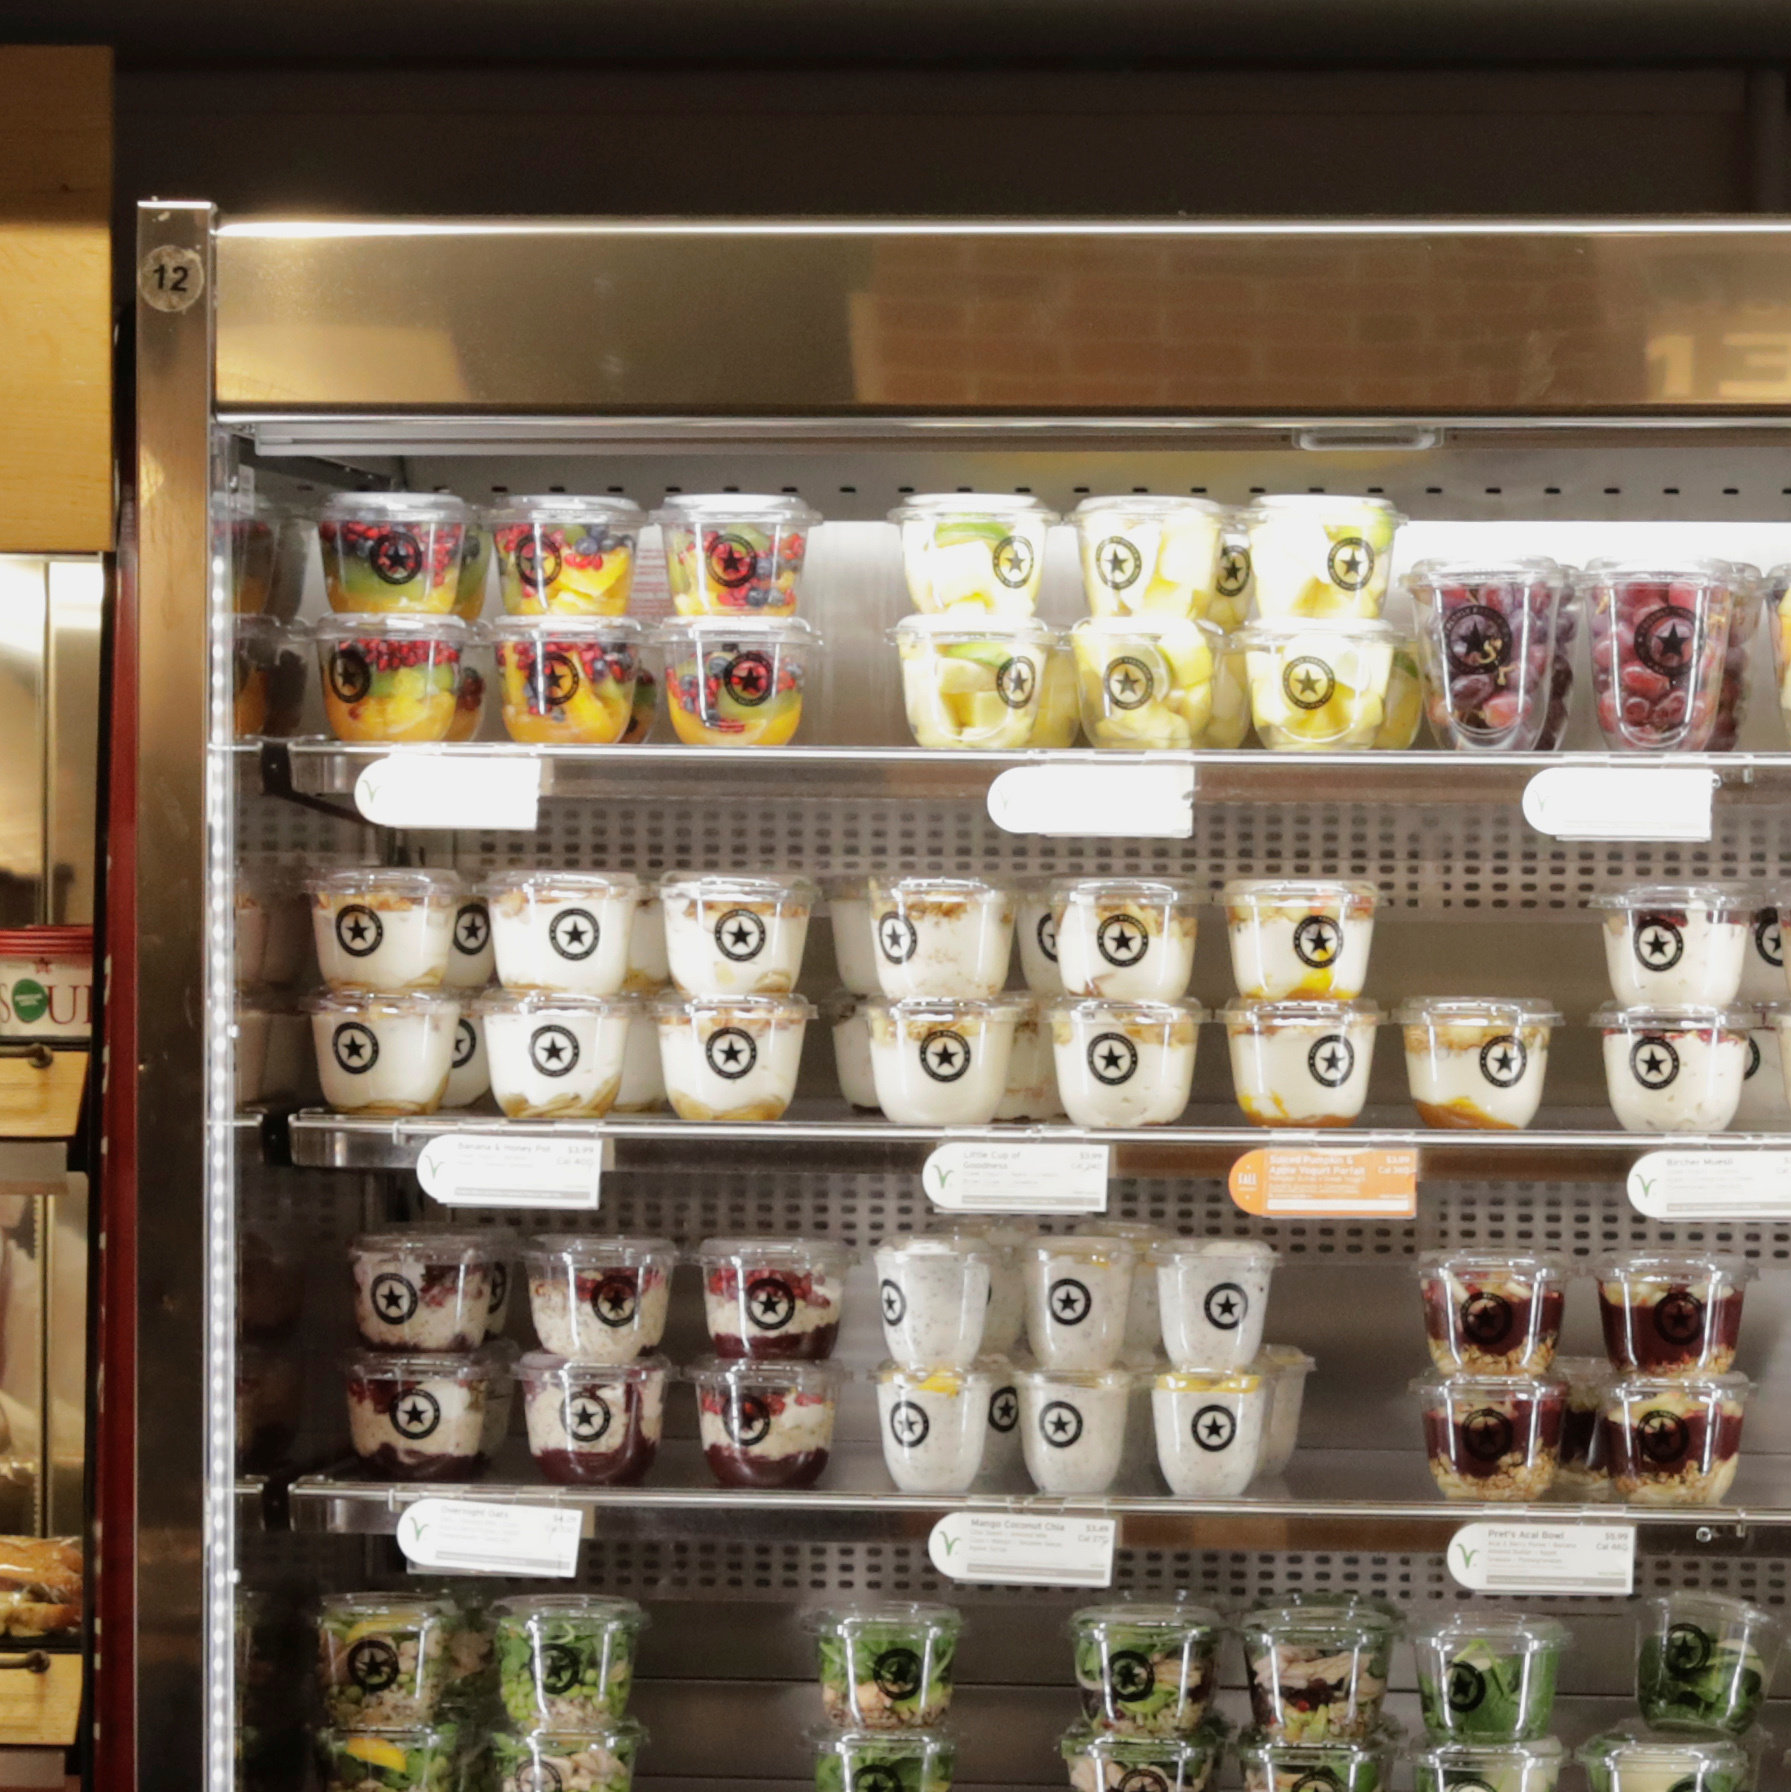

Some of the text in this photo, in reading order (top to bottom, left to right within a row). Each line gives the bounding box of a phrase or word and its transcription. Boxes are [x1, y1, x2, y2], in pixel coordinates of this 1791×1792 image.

[153, 264, 189, 292] 12
[963, 1151, 1010, 1163] Little Cup
[971, 1518, 1065, 1532] Mango Coconut Chia
[1487, 1529, 1515, 1540] Pret's
[1541, 1530, 1565, 1540] Bowl
